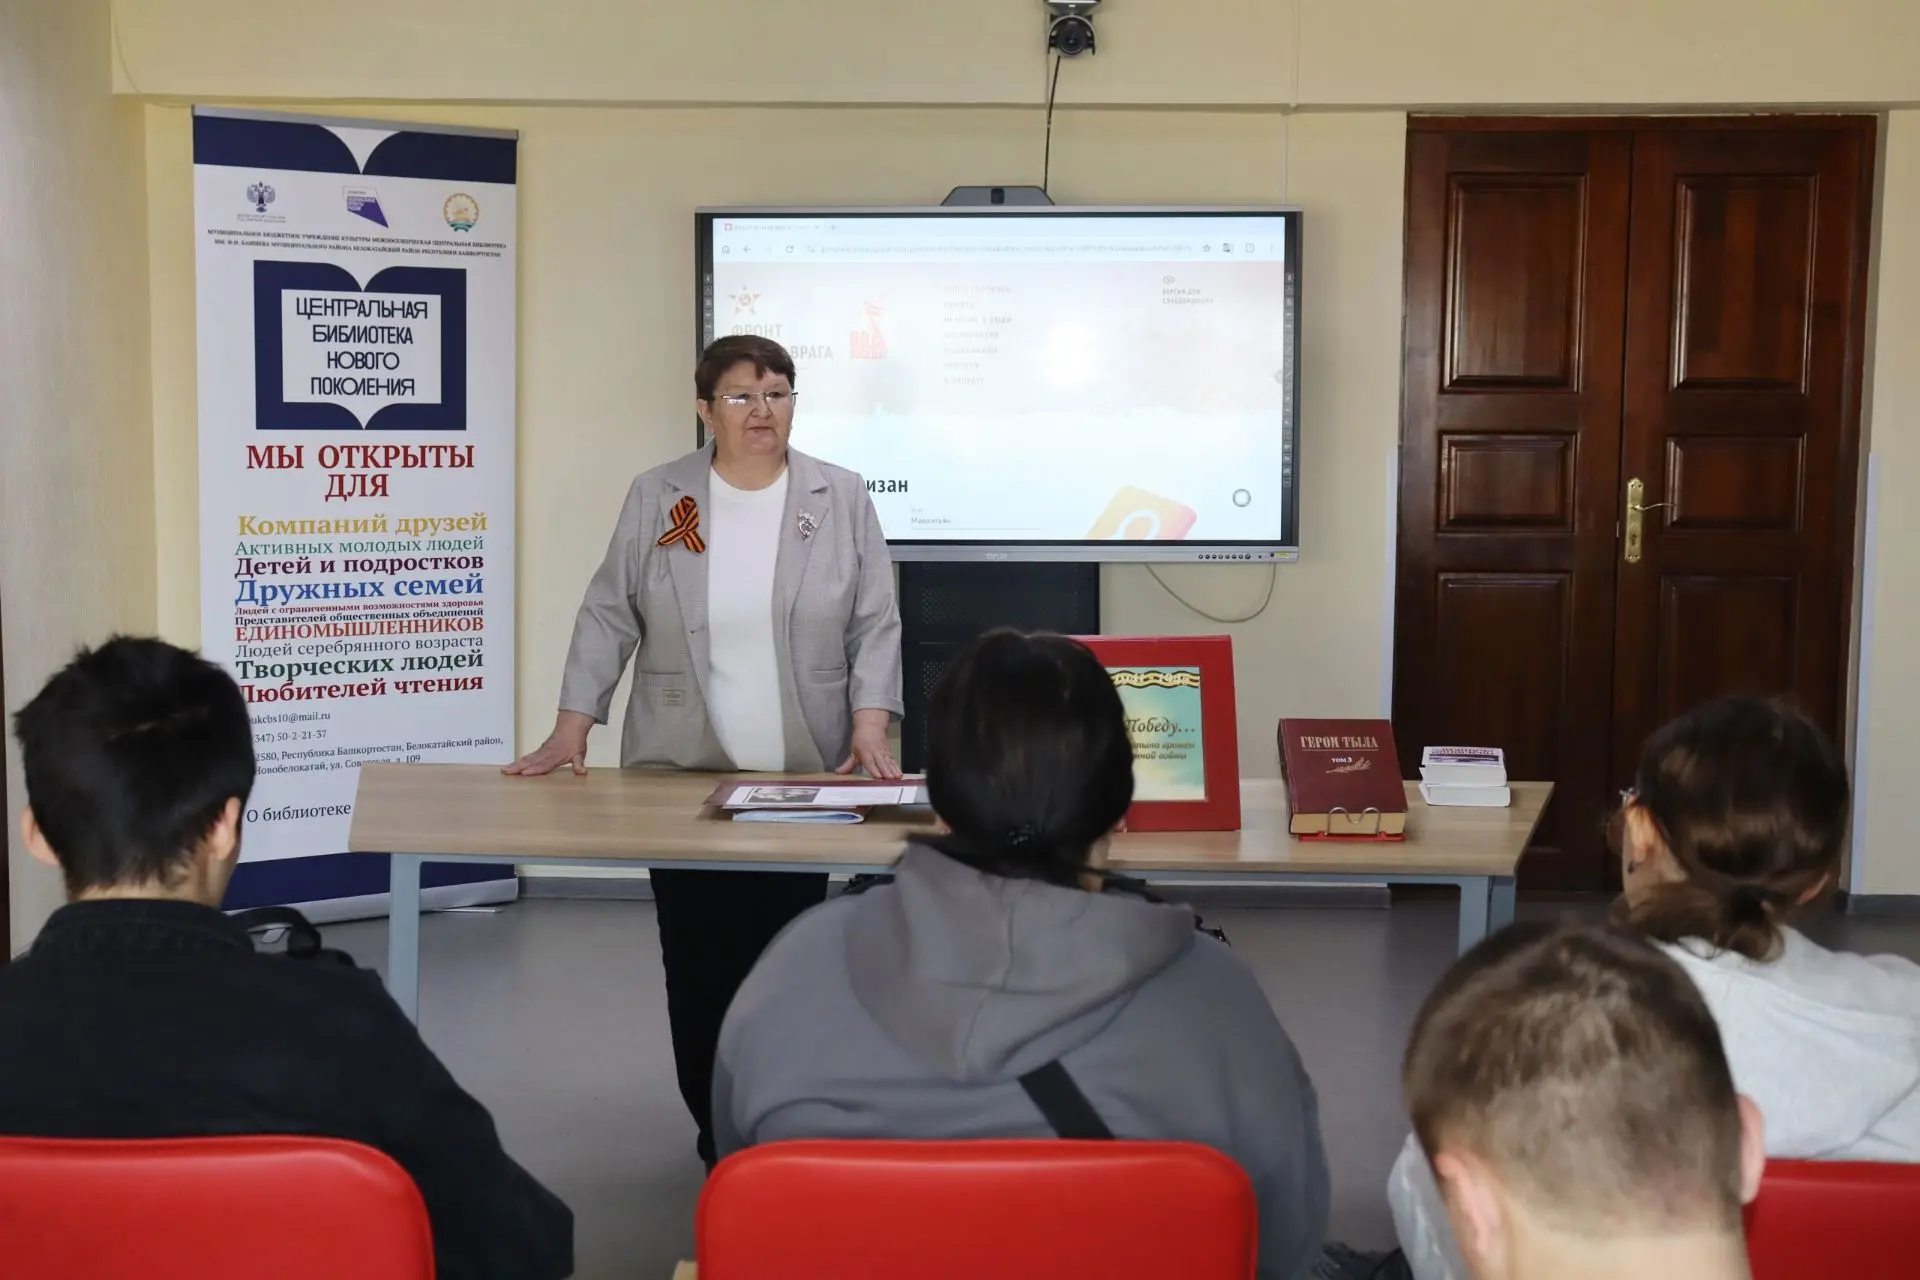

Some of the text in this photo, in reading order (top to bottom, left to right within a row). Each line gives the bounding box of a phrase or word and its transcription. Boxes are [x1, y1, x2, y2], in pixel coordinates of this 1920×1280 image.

[296, 297, 428, 320] ЦЕНТРАЛЬНАЯ
[312, 324, 413, 345] БИБЛИОТЕКА
[732, 323, 784, 337] ФРОНТ
[327, 350, 400, 370] НОВОГО
[790, 345, 834, 360] ВРАГА
[311, 376, 415, 397] ПОКОЛЕНИЯ
[246, 445, 475, 469] МЫ ОТКРЫТЫ
[325, 474, 389, 503] ДЛЯ
[866, 479, 908, 493] изан
[238, 512, 488, 537] Компаний друзей
[235, 536, 483, 556] Активных молодых людей
[234, 556, 484, 579] Детей и подростков
[235, 572, 484, 607] Дружных семей
[235, 606, 269, 616] Людей
[279, 603, 360, 615] ограниченными
[363, 601, 439, 611] возможностями
[442, 600, 484, 609] здоровья
[235, 608, 484, 627] Представителей общественных объединений
[236, 617, 484, 643] ЕДИНОМЫШЛЕННИКОВ
[235, 636, 484, 659] Людей серебрянного возраста
[235, 649, 484, 682] Творческих людей
[240, 676, 484, 703] Любителей чтения
[251, 712, 331, 725] ukcbs10@mail.ru
[255, 729, 328, 743] 347) 50-2-21-37
[1300, 735, 1380, 748] ГЕРОИ ТЫЛА
[255, 736, 503, 762] 2580, Республика Башкортостан, Белокатайский район,
[330, 762, 343, 772] ул.
[246, 804, 352, 823] О библиотеке
